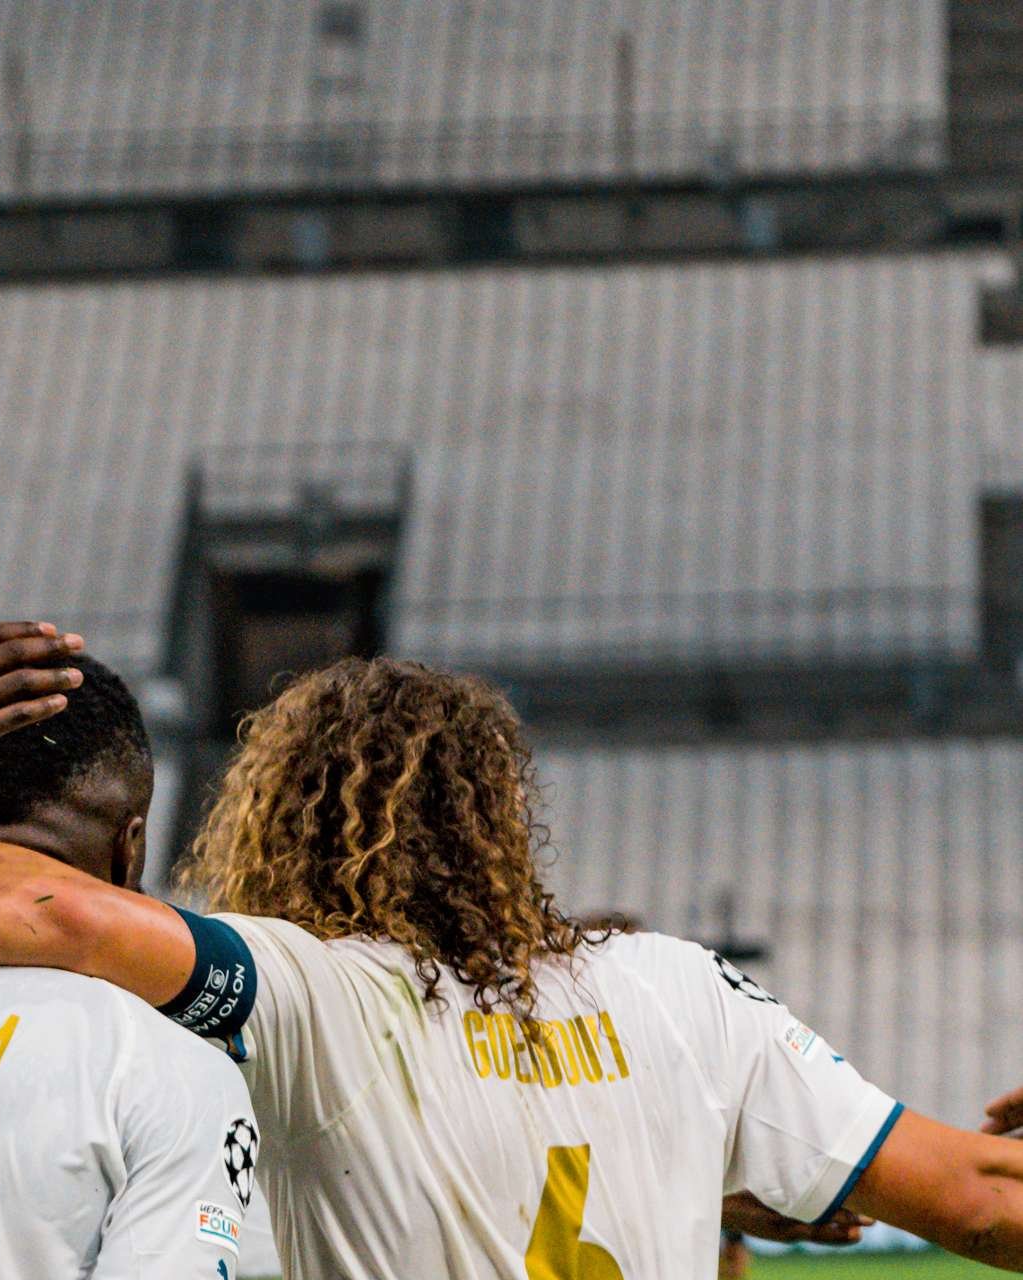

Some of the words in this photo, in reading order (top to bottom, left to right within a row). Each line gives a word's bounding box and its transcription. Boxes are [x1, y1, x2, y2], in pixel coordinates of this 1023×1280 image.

[232, 963, 246, 994] NO
[219, 997, 239, 1017] TO
[199, 1203, 224, 1216] UEFA
